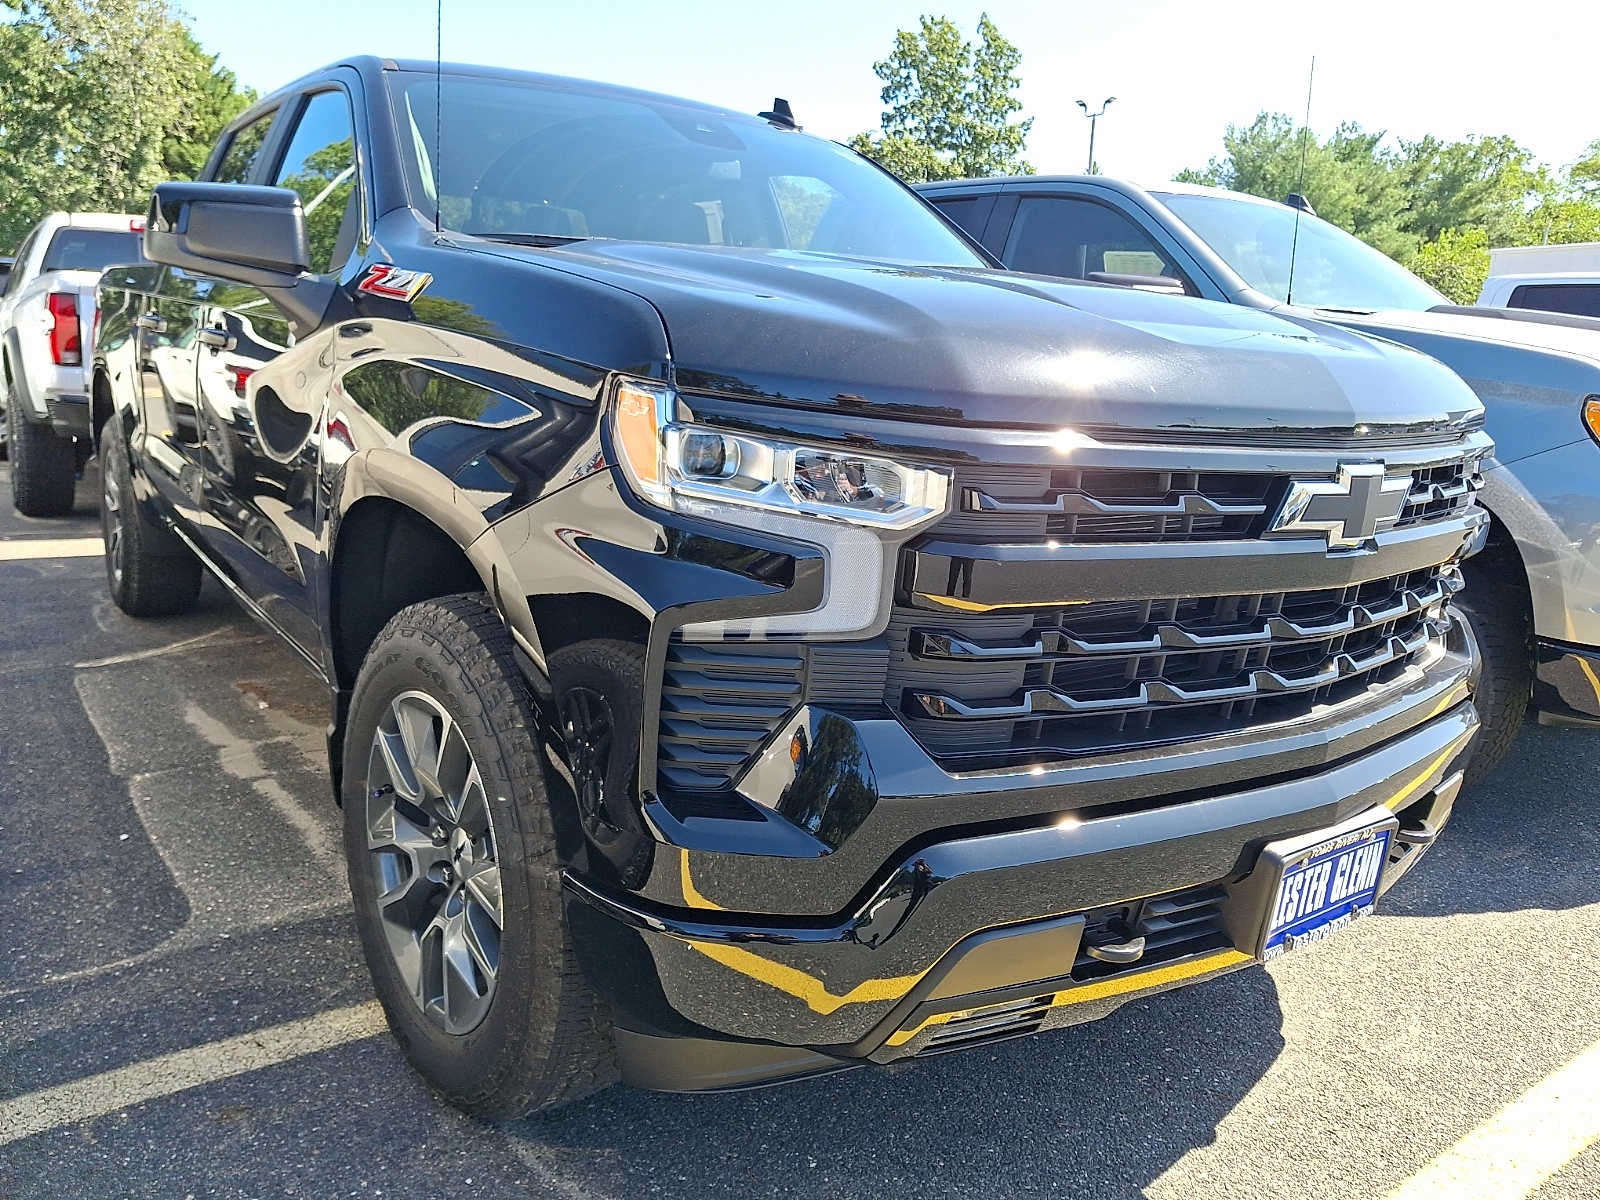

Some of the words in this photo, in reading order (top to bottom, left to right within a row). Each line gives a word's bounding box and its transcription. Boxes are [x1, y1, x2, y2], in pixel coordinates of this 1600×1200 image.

[359, 265, 427, 302] Z71
[1268, 860, 1333, 931] LESTER
[1329, 840, 1385, 904] GLENN
